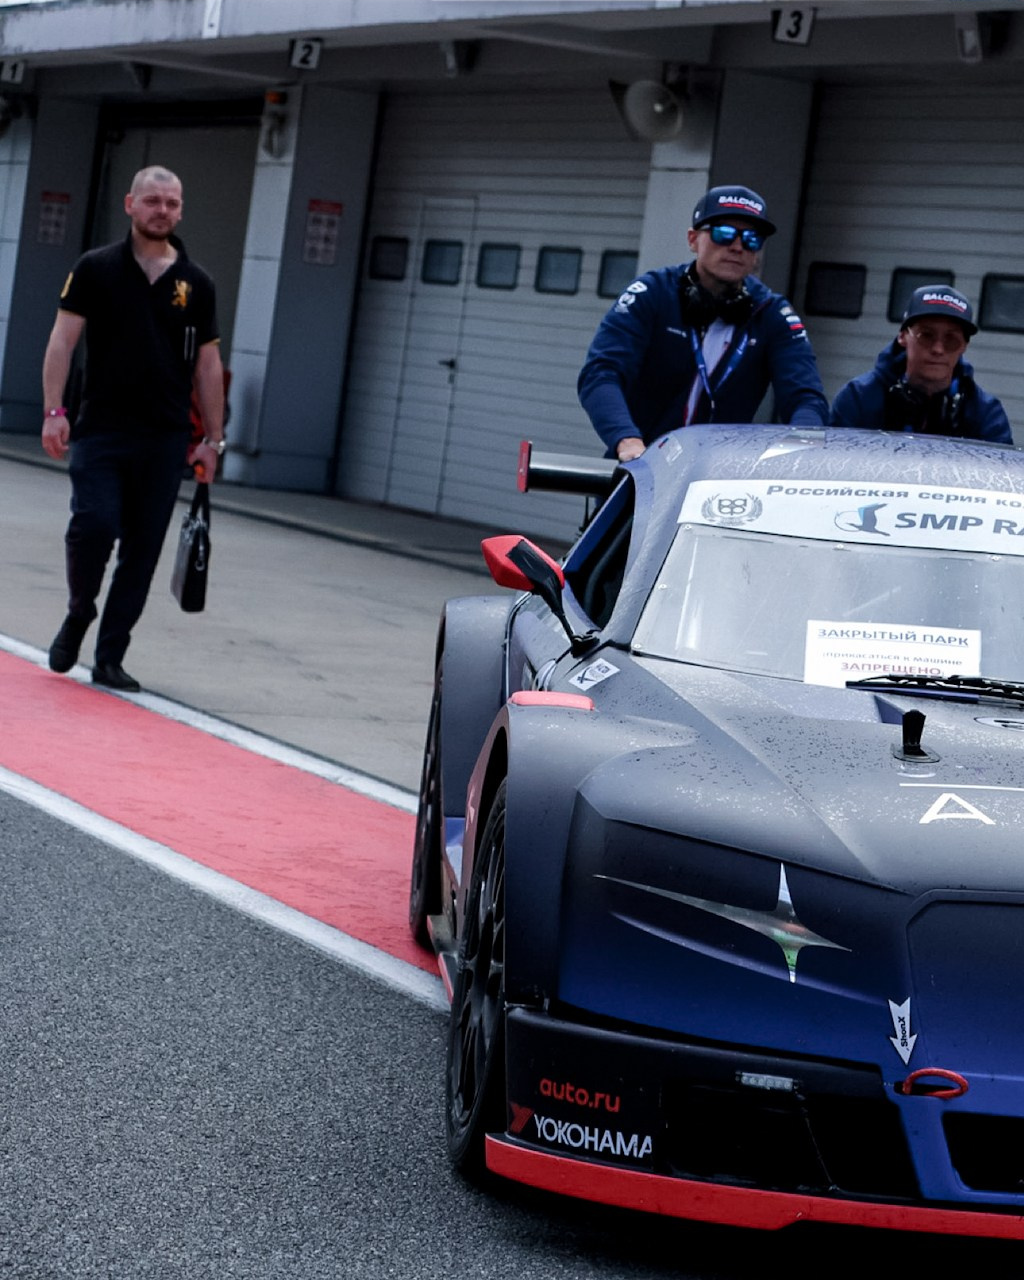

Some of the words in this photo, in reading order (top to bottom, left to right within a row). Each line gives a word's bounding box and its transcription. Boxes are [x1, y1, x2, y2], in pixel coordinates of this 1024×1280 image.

[786, 10, 804, 38] 3
[300, 44, 313, 65] 2
[766, 485, 909, 498] Российская
[918, 490, 987, 504] серия
[895, 511, 983, 532] SMP
[817, 628, 917, 642] ЗАКРЫТЫЙ
[923, 634, 969, 646] ПАРК
[539, 1077, 621, 1113] auto.ru
[533, 1114, 653, 1159] YOKOHAMA
